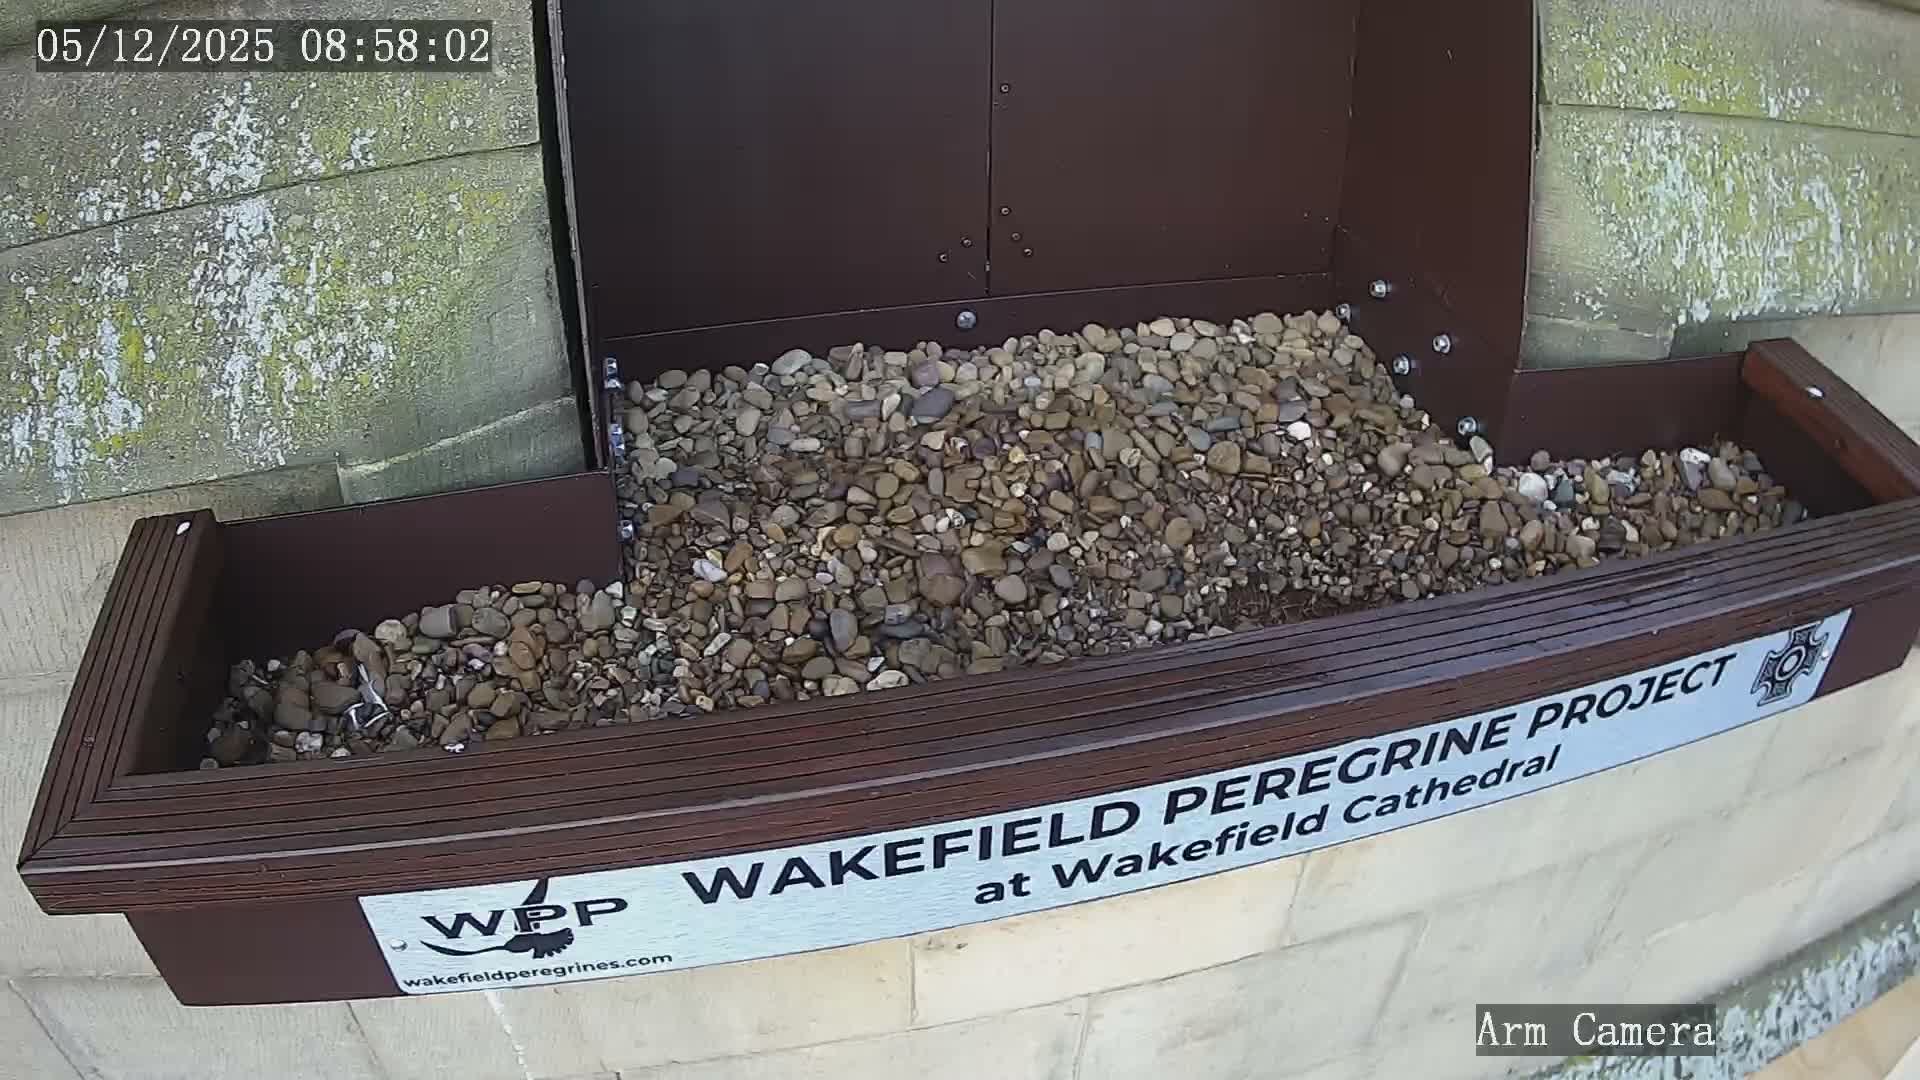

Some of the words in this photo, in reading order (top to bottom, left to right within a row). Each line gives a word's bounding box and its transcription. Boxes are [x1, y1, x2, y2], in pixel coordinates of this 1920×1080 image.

[682, 800, 1141, 905] WAKEFIELD
[1163, 712, 1517, 825] PEREGRINE
[1527, 653, 1737, 738] PROJECT
[974, 872, 1031, 905] at
[1052, 804, 1328, 888] Wakefield
[1343, 744, 1562, 825] Cathedral
[420, 897, 629, 939] WPP
[403, 953, 673, 988] wakefieldperegrines.com
